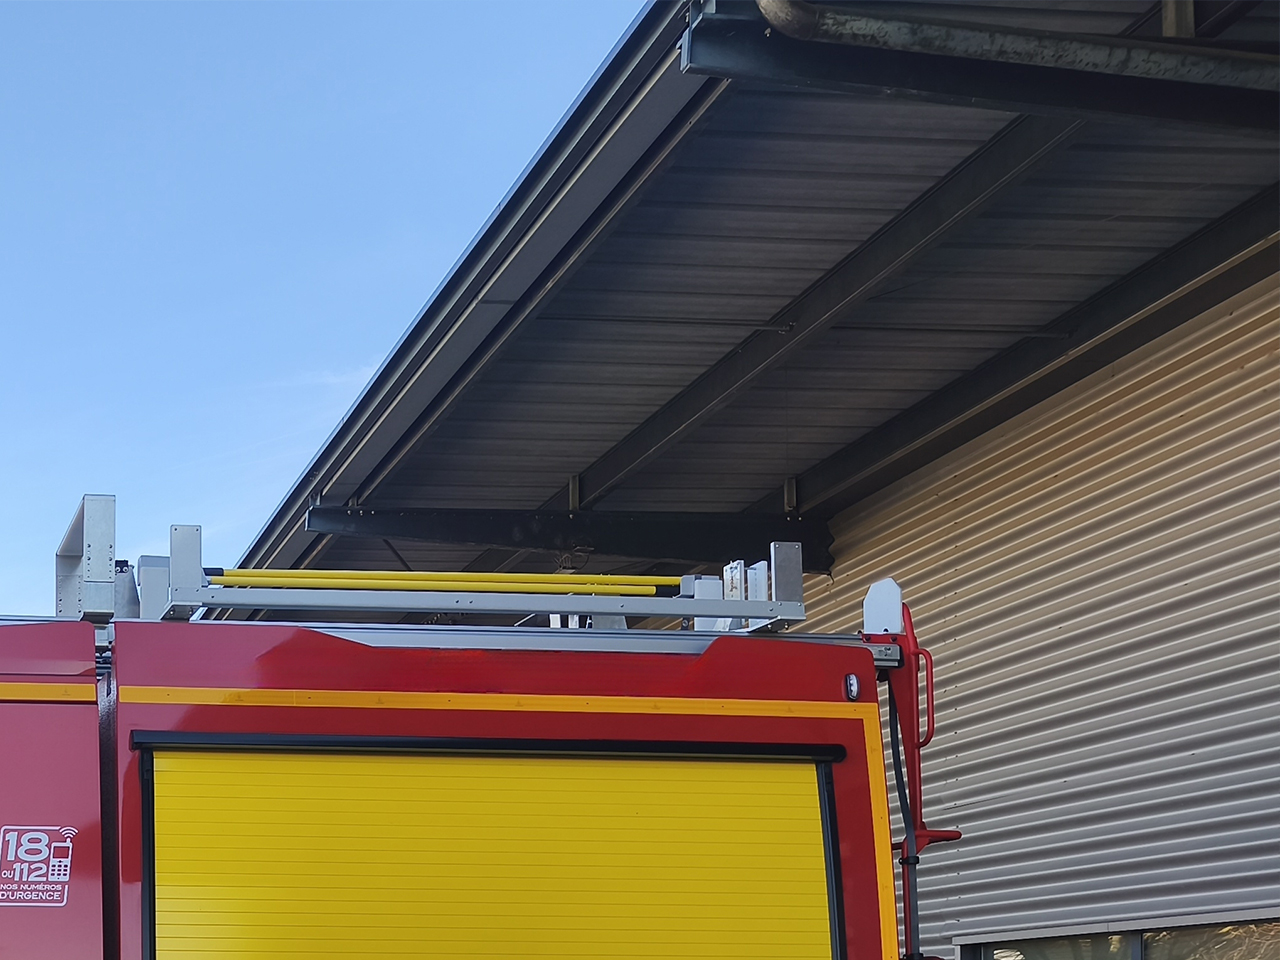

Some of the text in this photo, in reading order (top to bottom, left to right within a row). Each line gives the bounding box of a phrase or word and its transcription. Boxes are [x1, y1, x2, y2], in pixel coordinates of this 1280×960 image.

[5, 831, 50, 862] 18
[1, 862, 48, 882] OU 112
[0, 883, 18, 891] NOS
